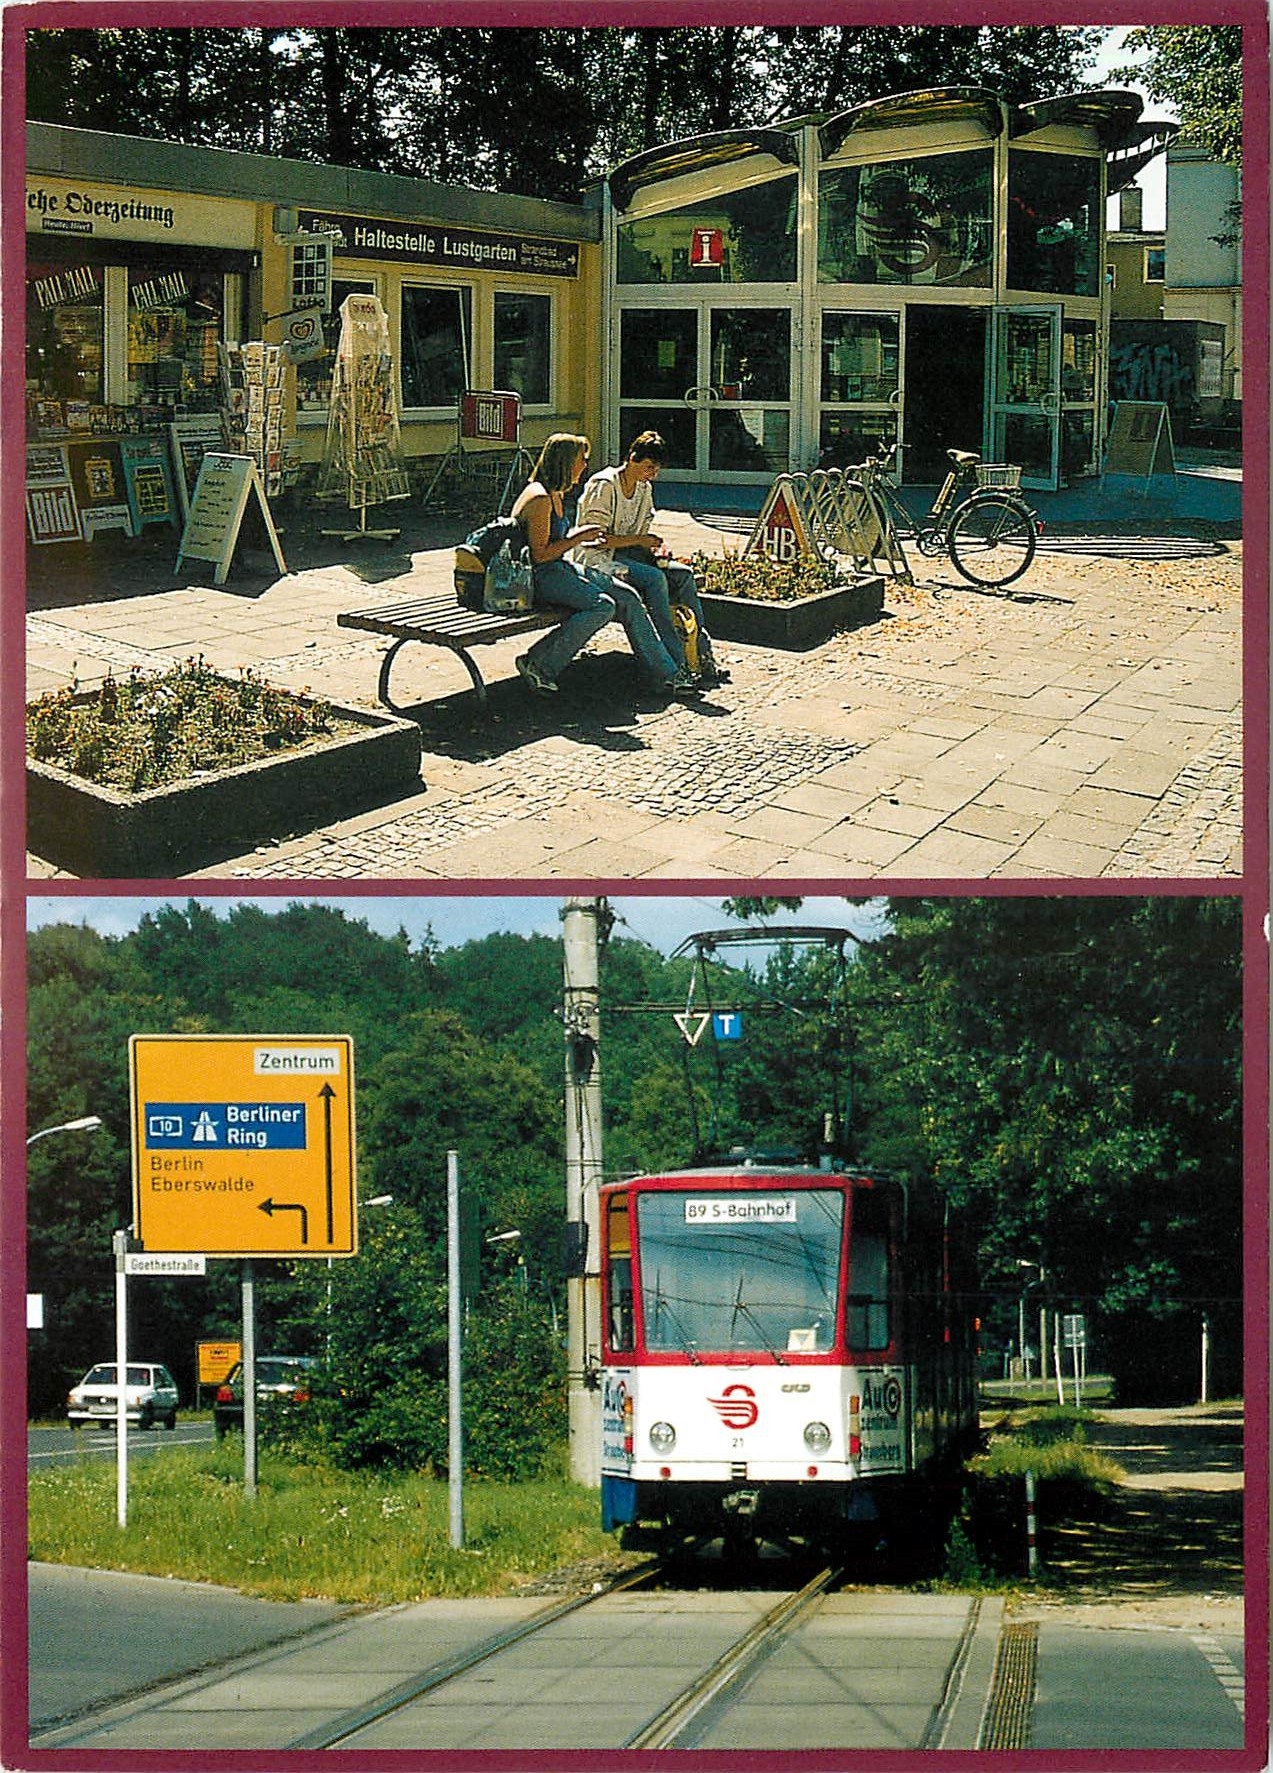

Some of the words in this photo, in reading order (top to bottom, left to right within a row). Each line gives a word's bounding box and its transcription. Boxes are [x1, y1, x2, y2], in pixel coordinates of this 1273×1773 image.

[24, 188, 58, 215] che
[64, 191, 174, 229] Oderzeitung
[354, 226, 436, 255] Haltestelle
[443, 236, 517, 262] Lustgarten
[35, 275, 65, 308] PALL
[64, 266, 98, 298] MALL
[132, 279, 161, 310] PALL
[158, 270, 191, 302] MALL
[479, 402, 500, 434] Bild
[31, 490, 75, 533] Bild
[762, 526, 797, 561] HB
[718, 1014, 735, 1035] T
[260, 1053, 335, 1069] Zentrum
[226, 1106, 301, 1123] Berliner
[159, 1120, 173, 1132] 10
[226, 1129, 268, 1147] Ring
[150, 1155, 204, 1171] Berlin
[150, 1176, 255, 1192] Eberswalde
[688, 1204, 706, 1218] 89
[712, 1202, 790, 1217] S-Bahnhof
[130, 1258, 200, 1271] Goethestraße
